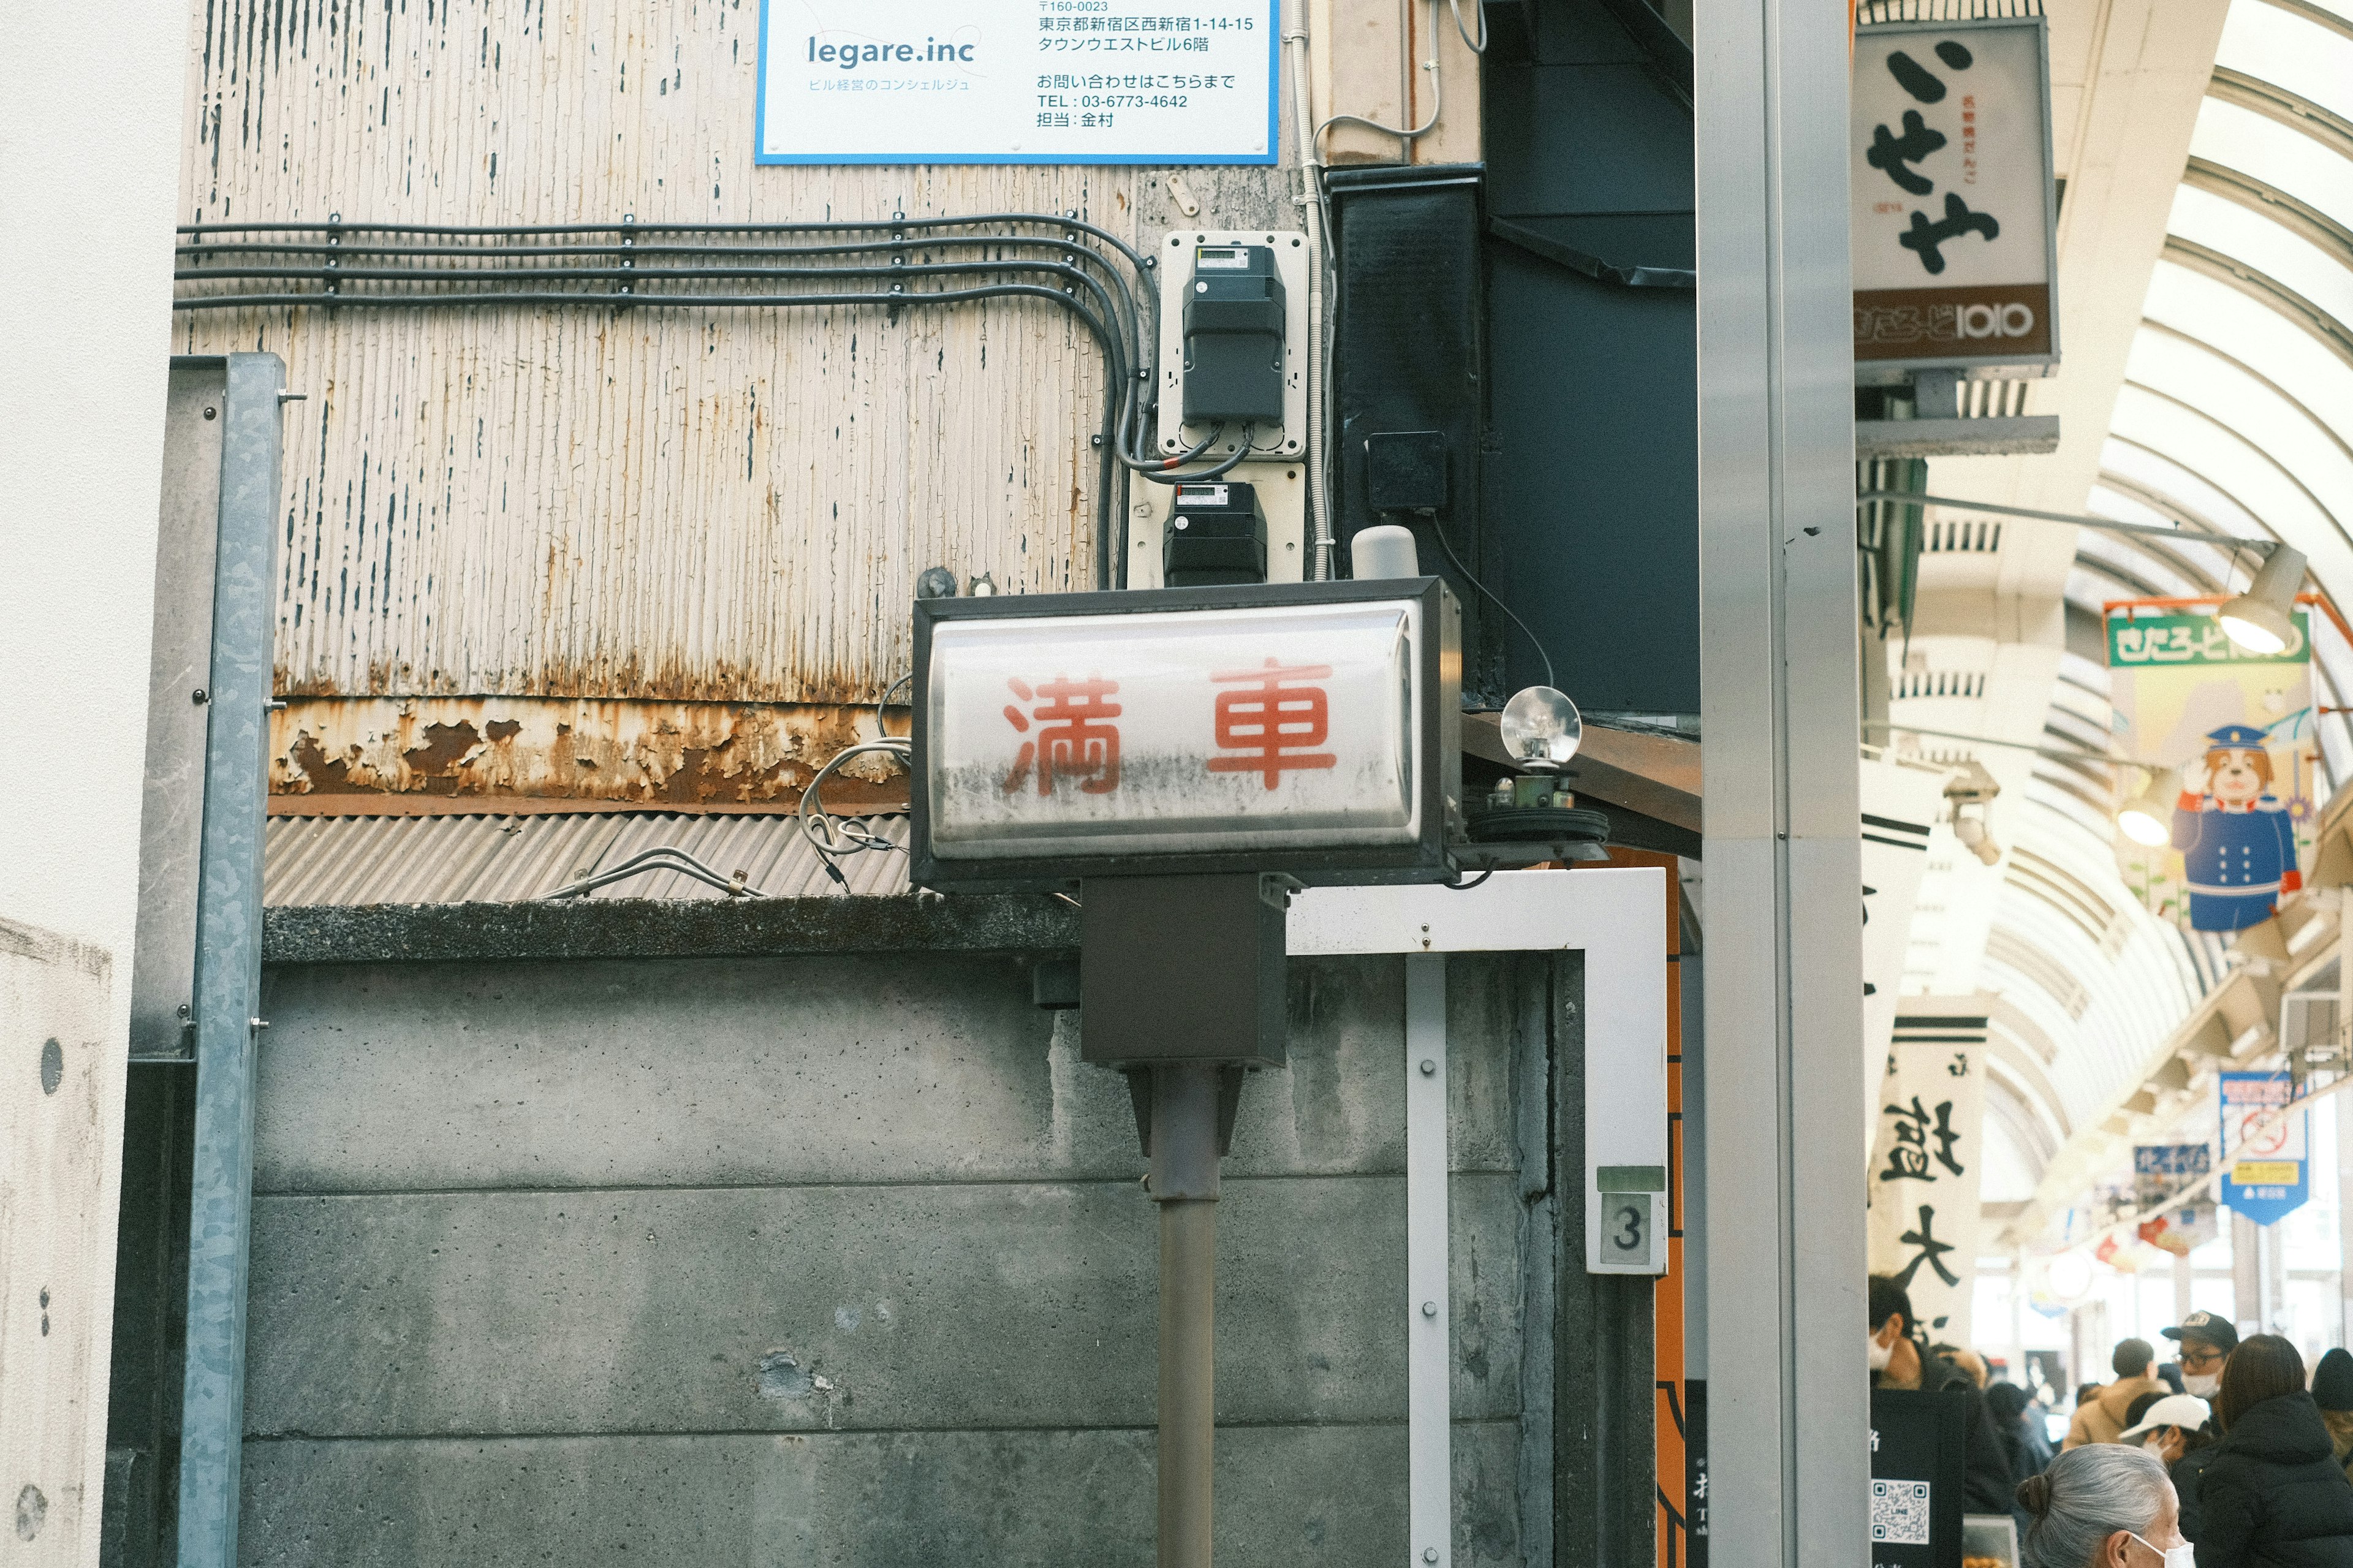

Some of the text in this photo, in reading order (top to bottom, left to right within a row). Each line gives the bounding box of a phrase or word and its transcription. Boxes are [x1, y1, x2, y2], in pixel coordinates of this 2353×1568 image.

[1039, 17, 1254, 32] 東京都新宿区西新宿1-14-15
[1039, 37, 1210, 52] タウンウエストビル6階
[809, 37, 974, 69] legare.inc
[809, 79, 970, 92] ビル経営のコンシェルジュ
[1037, 74, 1235, 89] お問い合わせはこちらまで
[1003, 657, 1337, 797] 満車
[1613, 1205, 1641, 1251] 3
